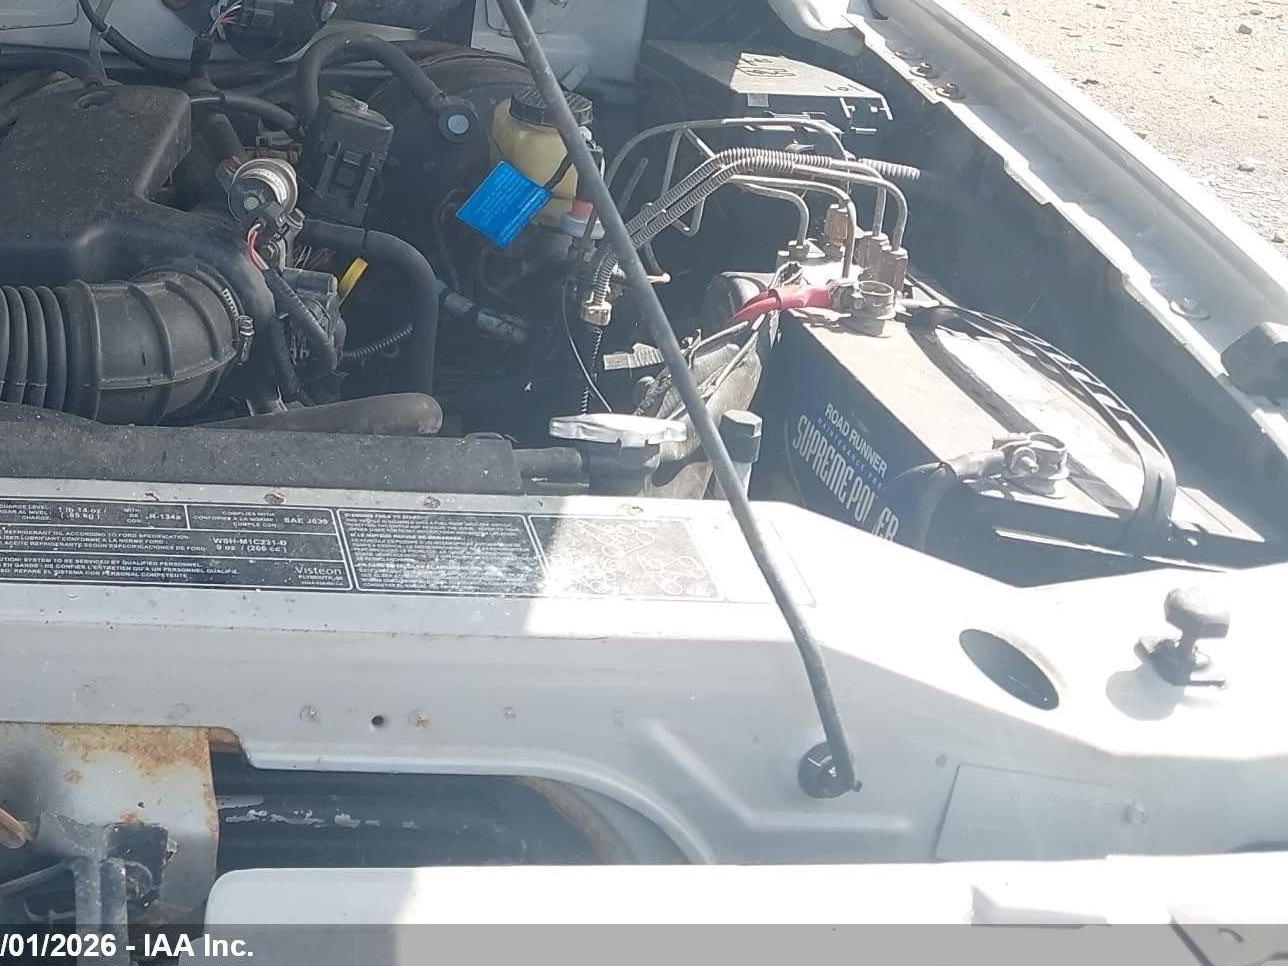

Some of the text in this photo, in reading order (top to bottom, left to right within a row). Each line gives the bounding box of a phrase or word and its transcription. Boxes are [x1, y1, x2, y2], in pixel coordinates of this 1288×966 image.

[792, 414, 854, 504] SUPREME
[825, 403, 888, 478] ROAD RUNNER
[295, 566, 342, 576] Visteon
